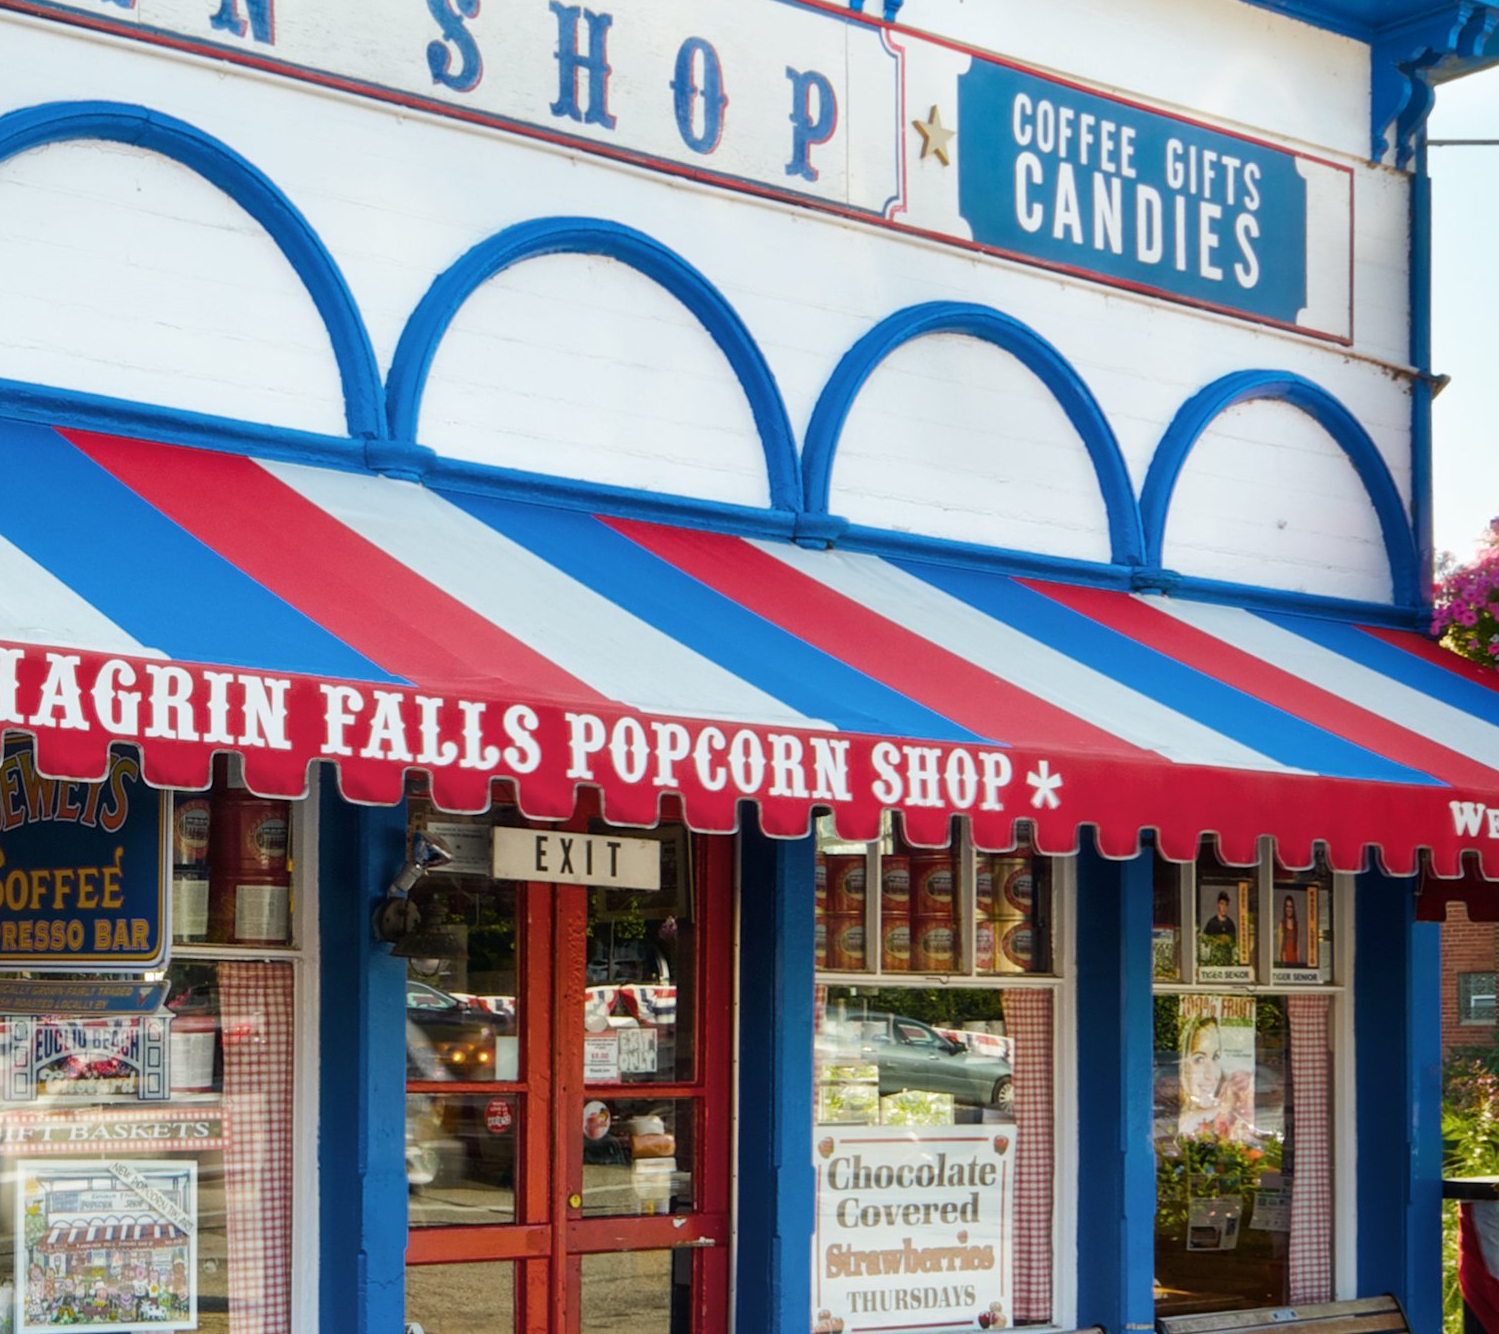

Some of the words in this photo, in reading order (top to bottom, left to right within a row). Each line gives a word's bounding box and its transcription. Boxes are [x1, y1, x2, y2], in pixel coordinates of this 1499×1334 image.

[1012, 91, 1137, 179] COFFEE
[1166, 138, 1262, 201] GIFTS
[1013, 150, 1261, 280] CANDIES
[319, 683, 542, 774] FALLS
[565, 711, 853, 802] POPCORN
[871, 740, 1014, 811] SHOP
[535, 835, 622, 877] EXIT
[94, 919, 150, 951] BAR
[1201, 970, 1223, 979] TIGER
[1293, 973, 1318, 981] SENIOR
[1182, 996, 1217, 1018] 100%
[1221, 997, 1254, 1018] FRUIT
[92, 1027, 140, 1062] BEACH
[620, 1029, 656, 1050] EXIT
[619, 1049, 656, 1073] ONLY
[68, 1121, 210, 1142] BASKETS
[113, 1163, 131, 1179] NEW
[827, 1153, 997, 1191] Chocolate
[836, 1192, 980, 1229] Covered
[826, 1237, 995, 1279] Strawberries
[846, 1285, 976, 1314] THURSDAYS
